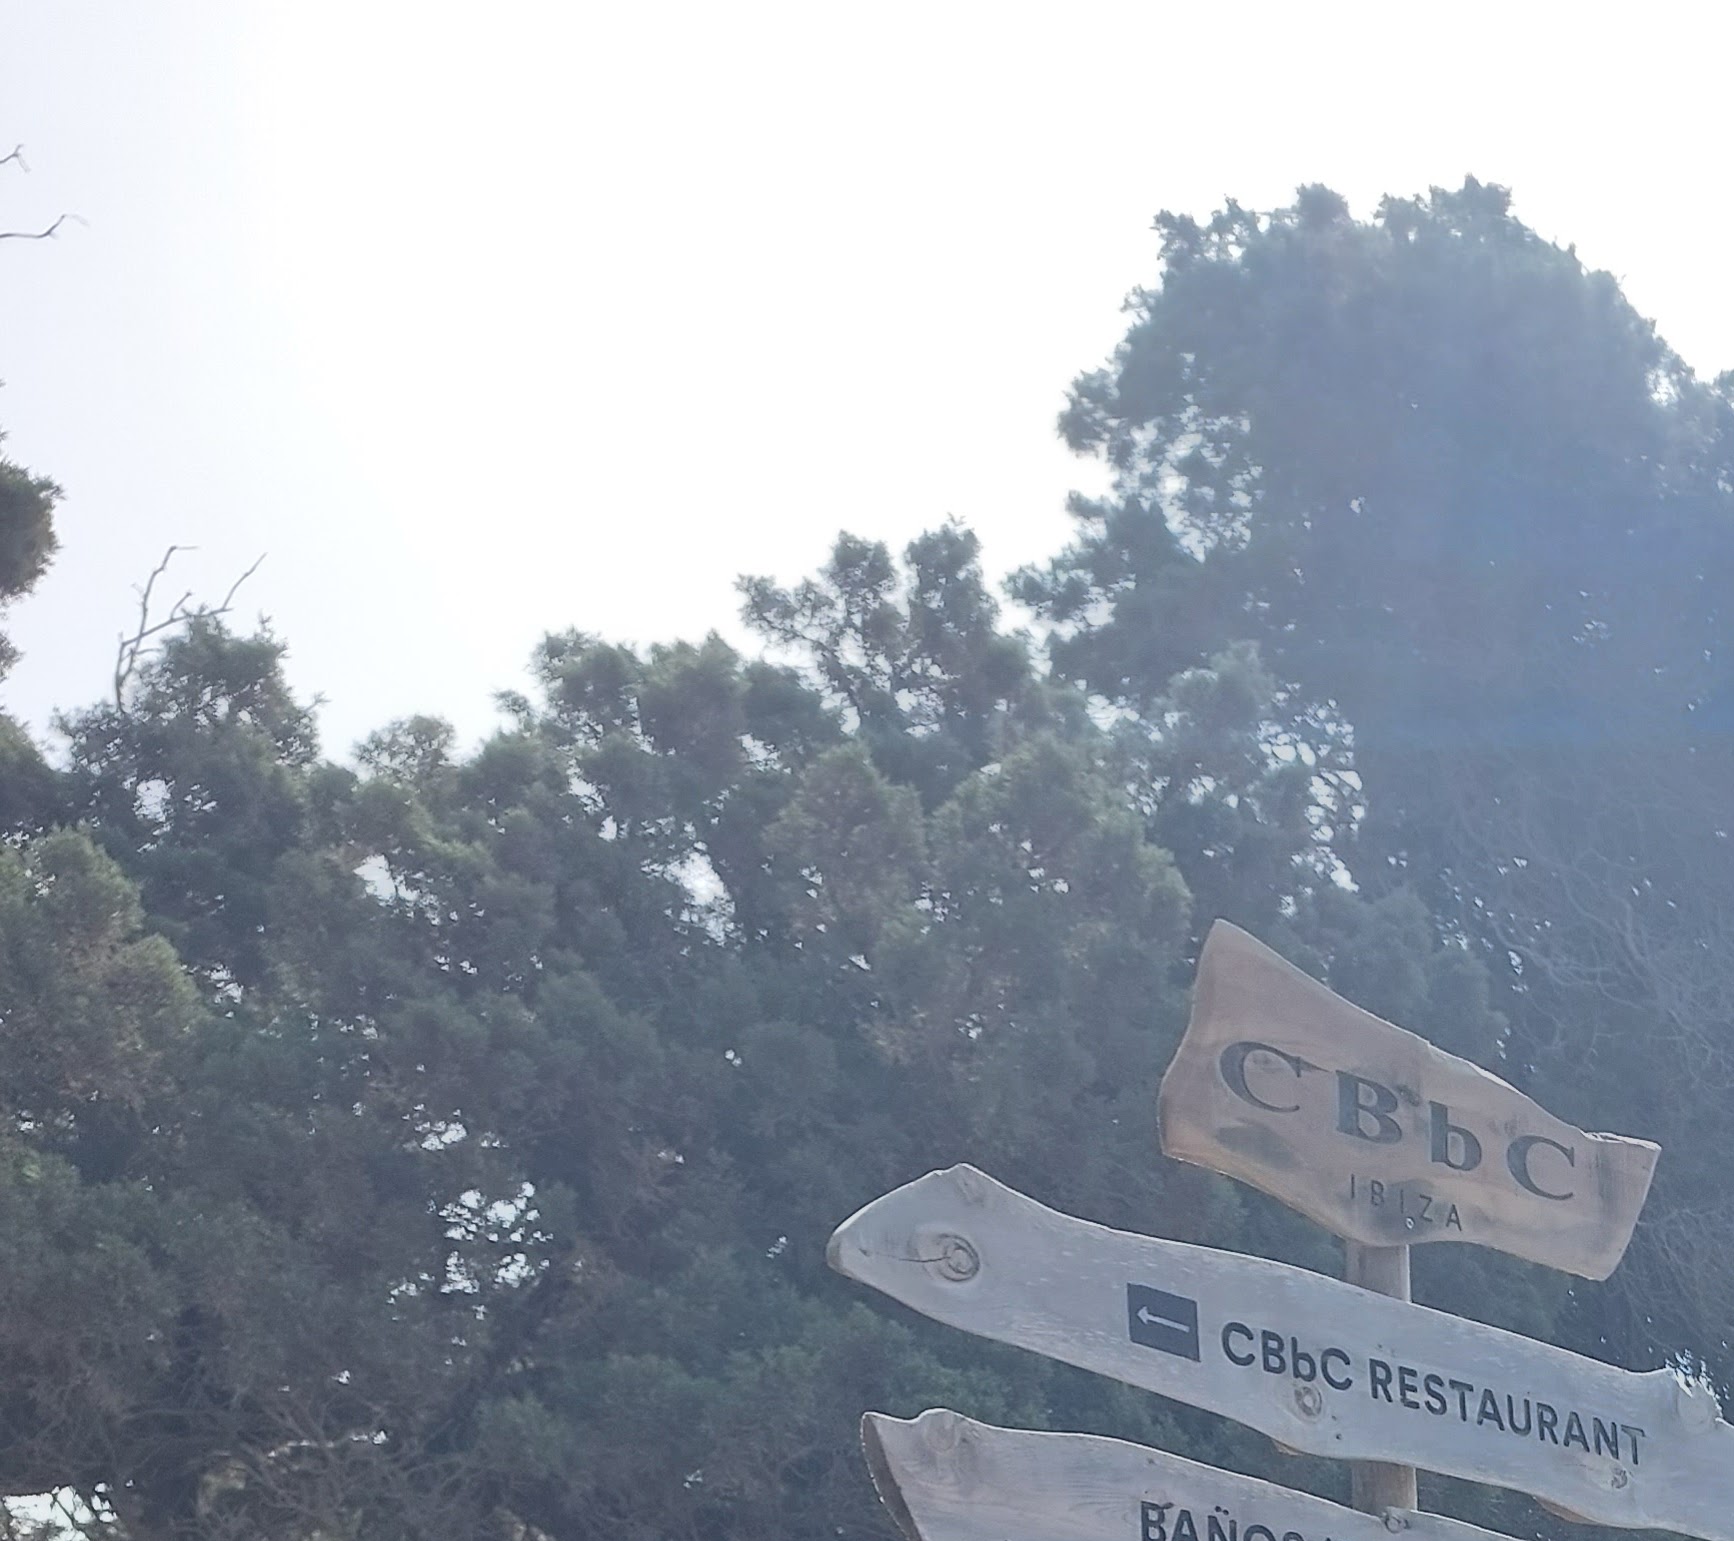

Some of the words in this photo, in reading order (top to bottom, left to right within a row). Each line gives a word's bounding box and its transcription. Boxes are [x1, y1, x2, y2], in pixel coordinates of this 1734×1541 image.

[1218, 1039, 1575, 1201] CBbC
[1350, 1173, 1463, 1232] IBIZA
[1221, 1322, 1351, 1392] CBbC
[1369, 1358, 1647, 1466] RESTAURANT
